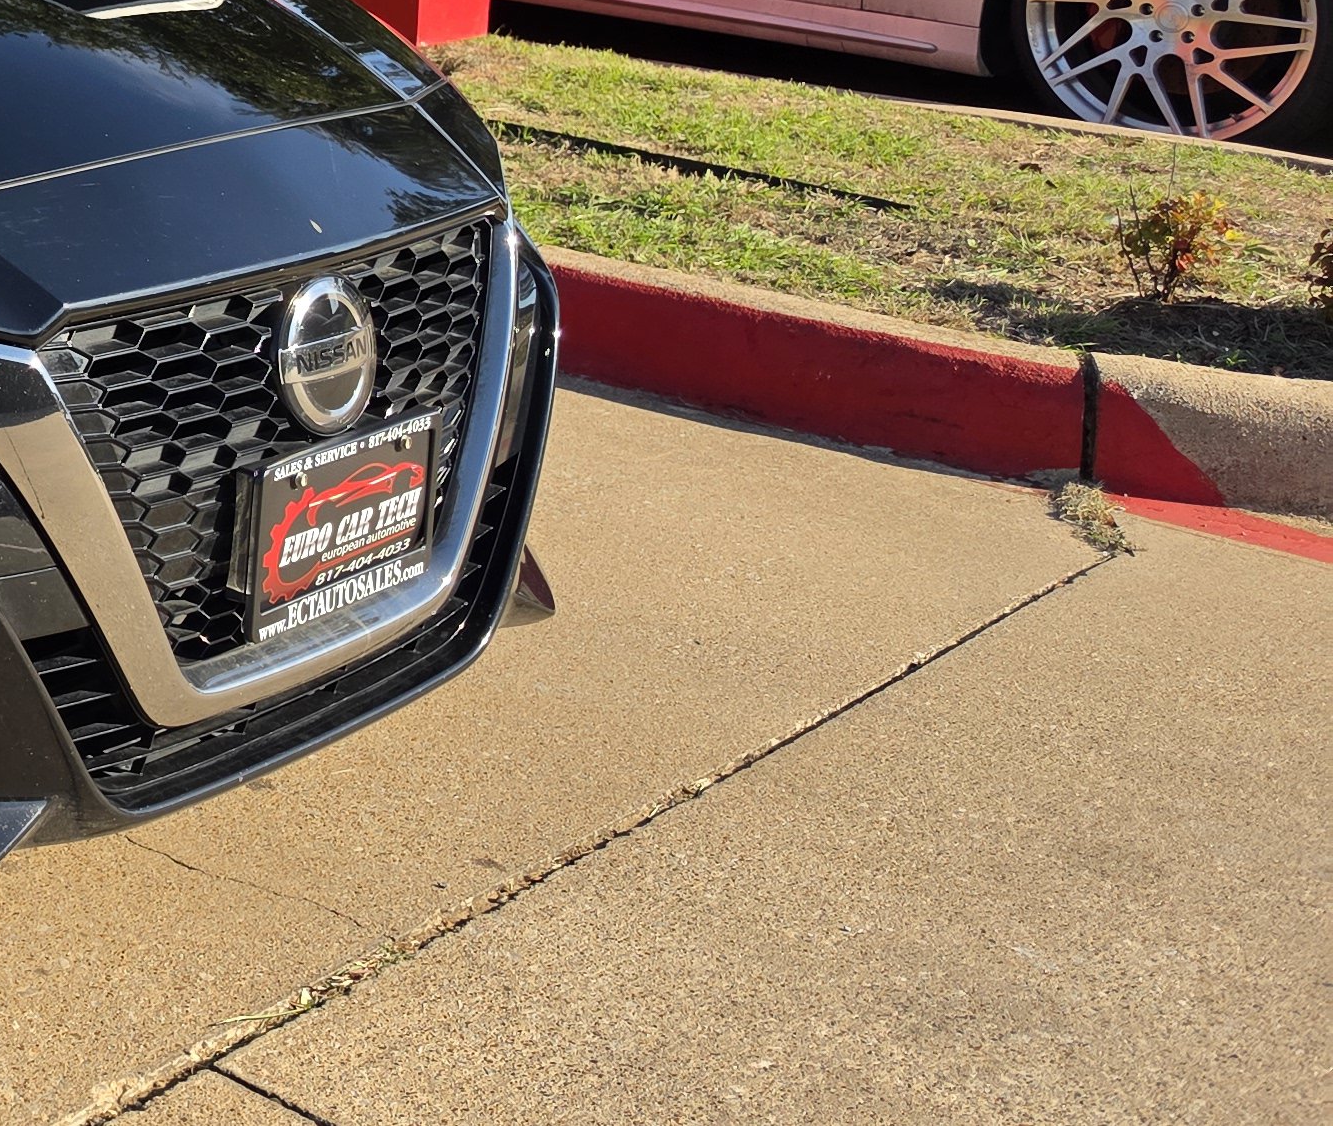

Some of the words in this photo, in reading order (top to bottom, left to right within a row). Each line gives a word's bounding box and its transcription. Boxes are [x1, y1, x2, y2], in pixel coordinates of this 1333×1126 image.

[295, 334, 367, 375] NISSAN
[273, 458, 303, 482] SALES
[303, 456, 314, 471] &
[314, 441, 358, 468] SERVICE
[368, 416, 432, 449] 817-404-4033
[278, 521, 334, 568] EURO
[335, 506, 374, 546] CAR
[374, 486, 423, 531] TECH
[321, 537, 365, 563] european
[365, 517, 417, 545] automotive
[315, 537, 412, 586] 817-404-4033
[258, 559, 425, 643] www.ECTAUTOSALES.com
